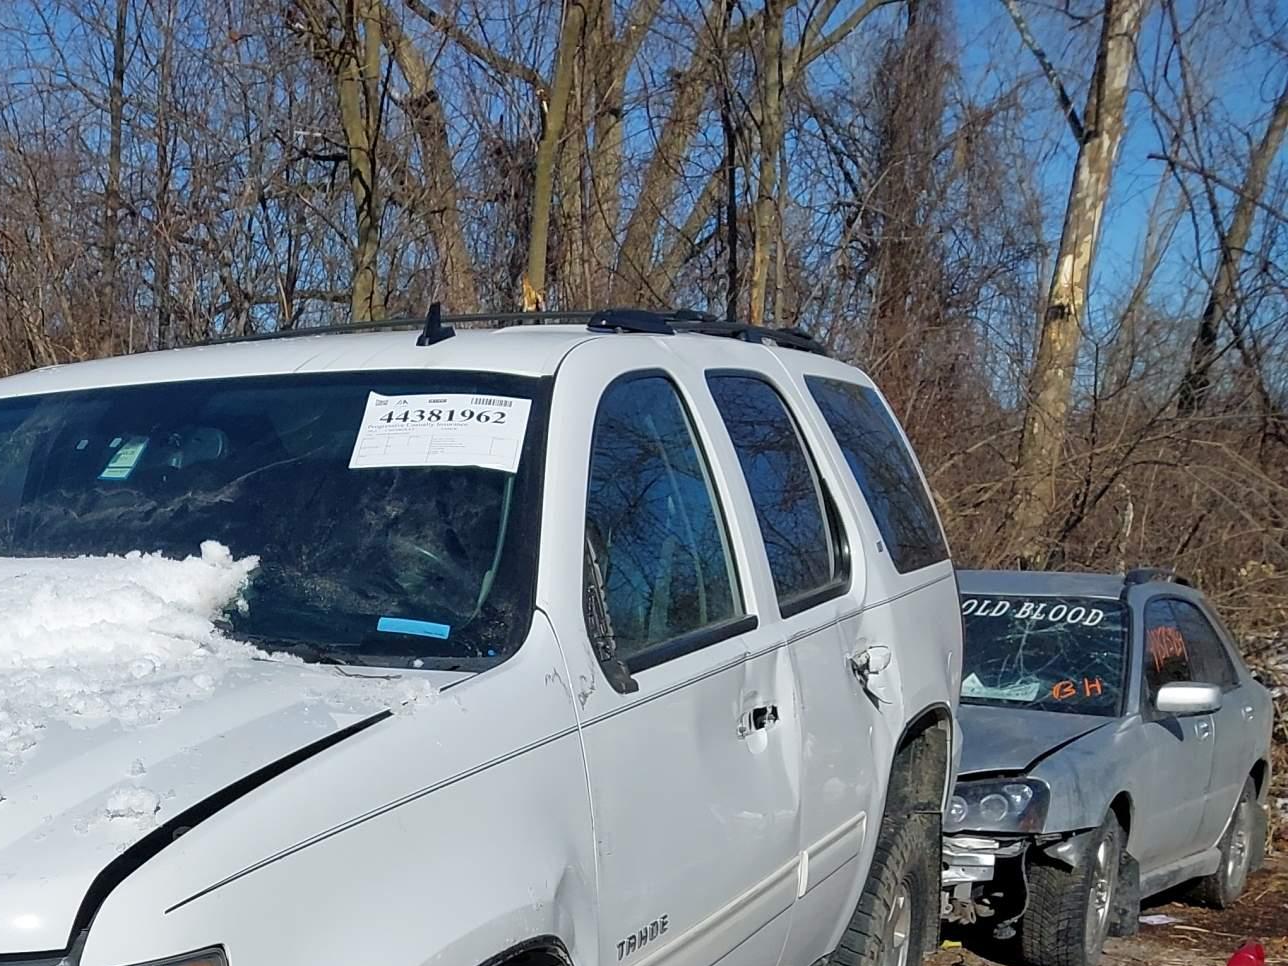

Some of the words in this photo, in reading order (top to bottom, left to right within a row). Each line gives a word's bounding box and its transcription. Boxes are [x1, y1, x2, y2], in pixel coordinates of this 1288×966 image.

[379, 408, 507, 424] 44381962
[1014, 602, 1104, 626] BLOOD
[616, 913, 669, 961] TAHOE
